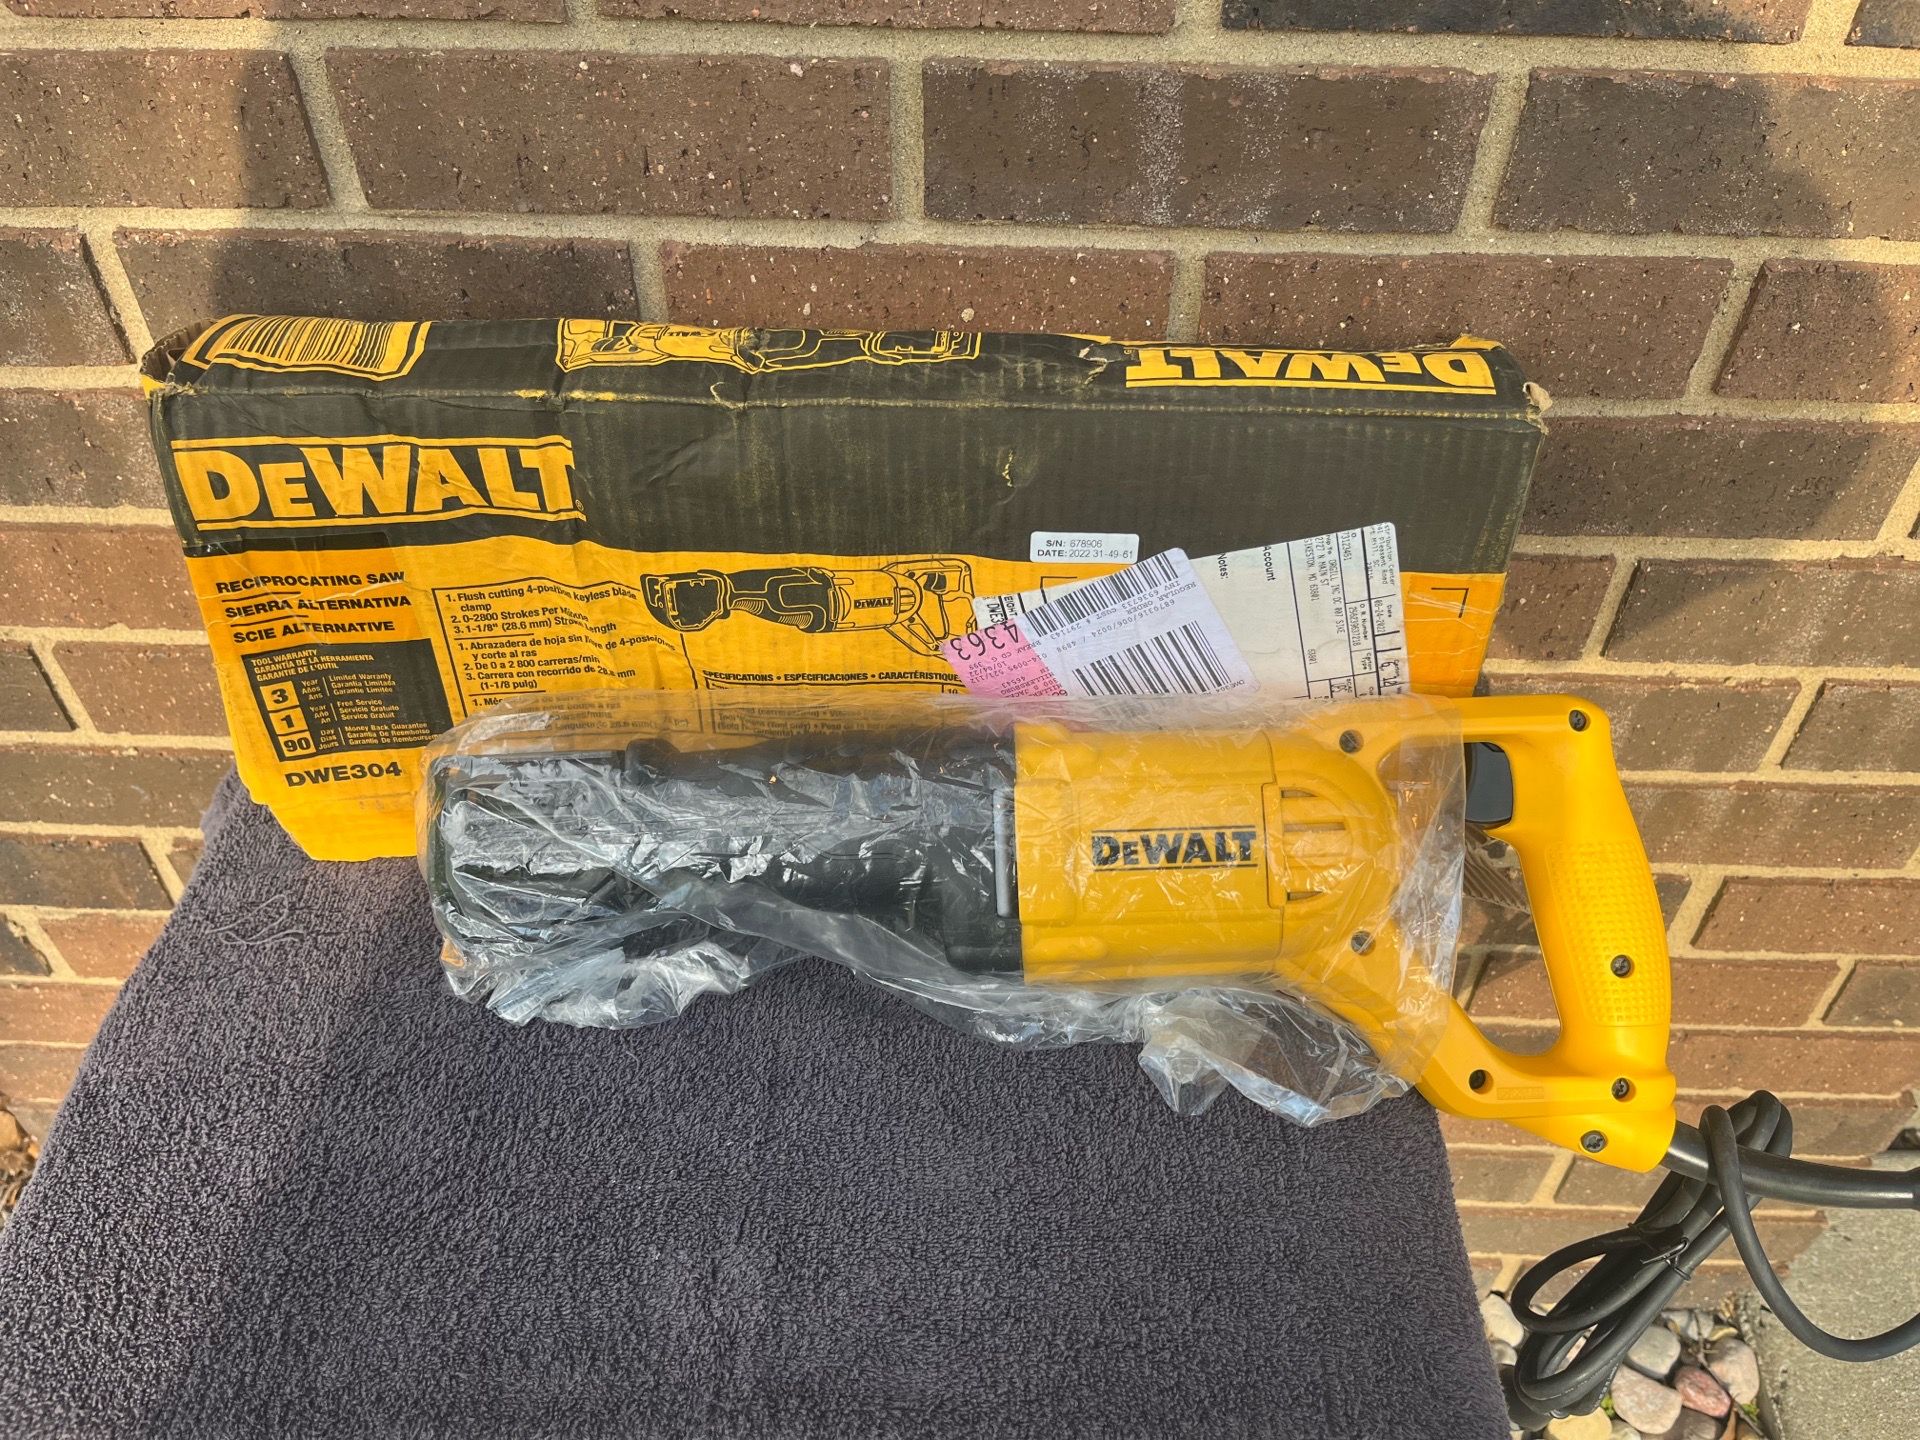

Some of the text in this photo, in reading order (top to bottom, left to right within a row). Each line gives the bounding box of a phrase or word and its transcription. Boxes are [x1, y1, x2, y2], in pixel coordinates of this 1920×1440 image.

[1126, 349, 1495, 387] DEWALT
[174, 444, 575, 521] DEWALT
[1046, 539, 1103, 548] S/N: 678906
[1037, 549, 1067, 557] DATE:
[1069, 549, 1091, 557] 2022
[1318, 561, 1328, 577] MAIN
[216, 572, 404, 593] RECIPROCATING SAW
[1164, 580, 1181, 592] INV
[446, 594, 457, 602] 1.
[457, 592, 486, 602] Flush
[488, 588, 524, 600] cutting
[573, 589, 610, 603] keyless
[612, 587, 637, 600] blade
[1157, 581, 1197, 602] REGULAR
[225, 596, 411, 618] SIERRA ALTERNATIVA
[460, 602, 492, 612] clamp
[854, 597, 893, 609] DEWALT
[1003, 595, 1018, 617] EIGHT
[1125, 599, 1154, 615] ORDER
[451, 615, 461, 624] 2.
[462, 612, 499, 623] 0-2800
[500, 609, 540, 620] Strokes
[541, 607, 558, 615] Per
[986, 603, 1005, 625] DWE3
[1096, 606, 1117, 621] CUST
[233, 621, 395, 643] SCIE ALTERNATIVE
[454, 626, 464, 634] 3.
[501, 620, 528, 632] (28.6
[529, 617, 552, 628] mm)
[458, 643, 469, 651] 1.
[470, 640, 527, 650] Abrazadera
[530, 638, 542, 646] de
[544, 636, 566, 646] hoja
[568, 635, 582, 643] sin
[605, 641, 617, 649] de
[949, 621, 1019, 661] 4363
[251, 650, 317, 666] TOOL WARRANTY
[296, 658, 308, 667] DE
[308, 656, 319, 664] LA
[320, 654, 374, 662] HERRAMIENTA
[481, 651, 507, 660] corte
[509, 650, 519, 658] al
[256, 668, 297, 681] GARANTIE
[298, 664, 309, 674] DE
[463, 663, 474, 671] 2.
[475, 662, 488, 670] De
[490, 661, 498, 669] 0
[508, 661, 516, 669] 2
[517, 660, 536, 669] 800
[466, 665, 636, 680] 3. Carrera con recorrido de mm
[359, 673, 392, 681] Warranty
[702, 669, 774, 681] SPECIFICATIONS
[783, 672, 868, 682] ESPECIFICACIONES
[480, 679, 538, 691] (1-1/8 pulg)
[271, 688, 289, 704] 3
[473, 698, 483, 706] 1.
[281, 715, 294, 729] 1
[283, 737, 311, 752] 90
[284, 761, 402, 787] DWE304
[1091, 831, 1257, 866] DEWALT
